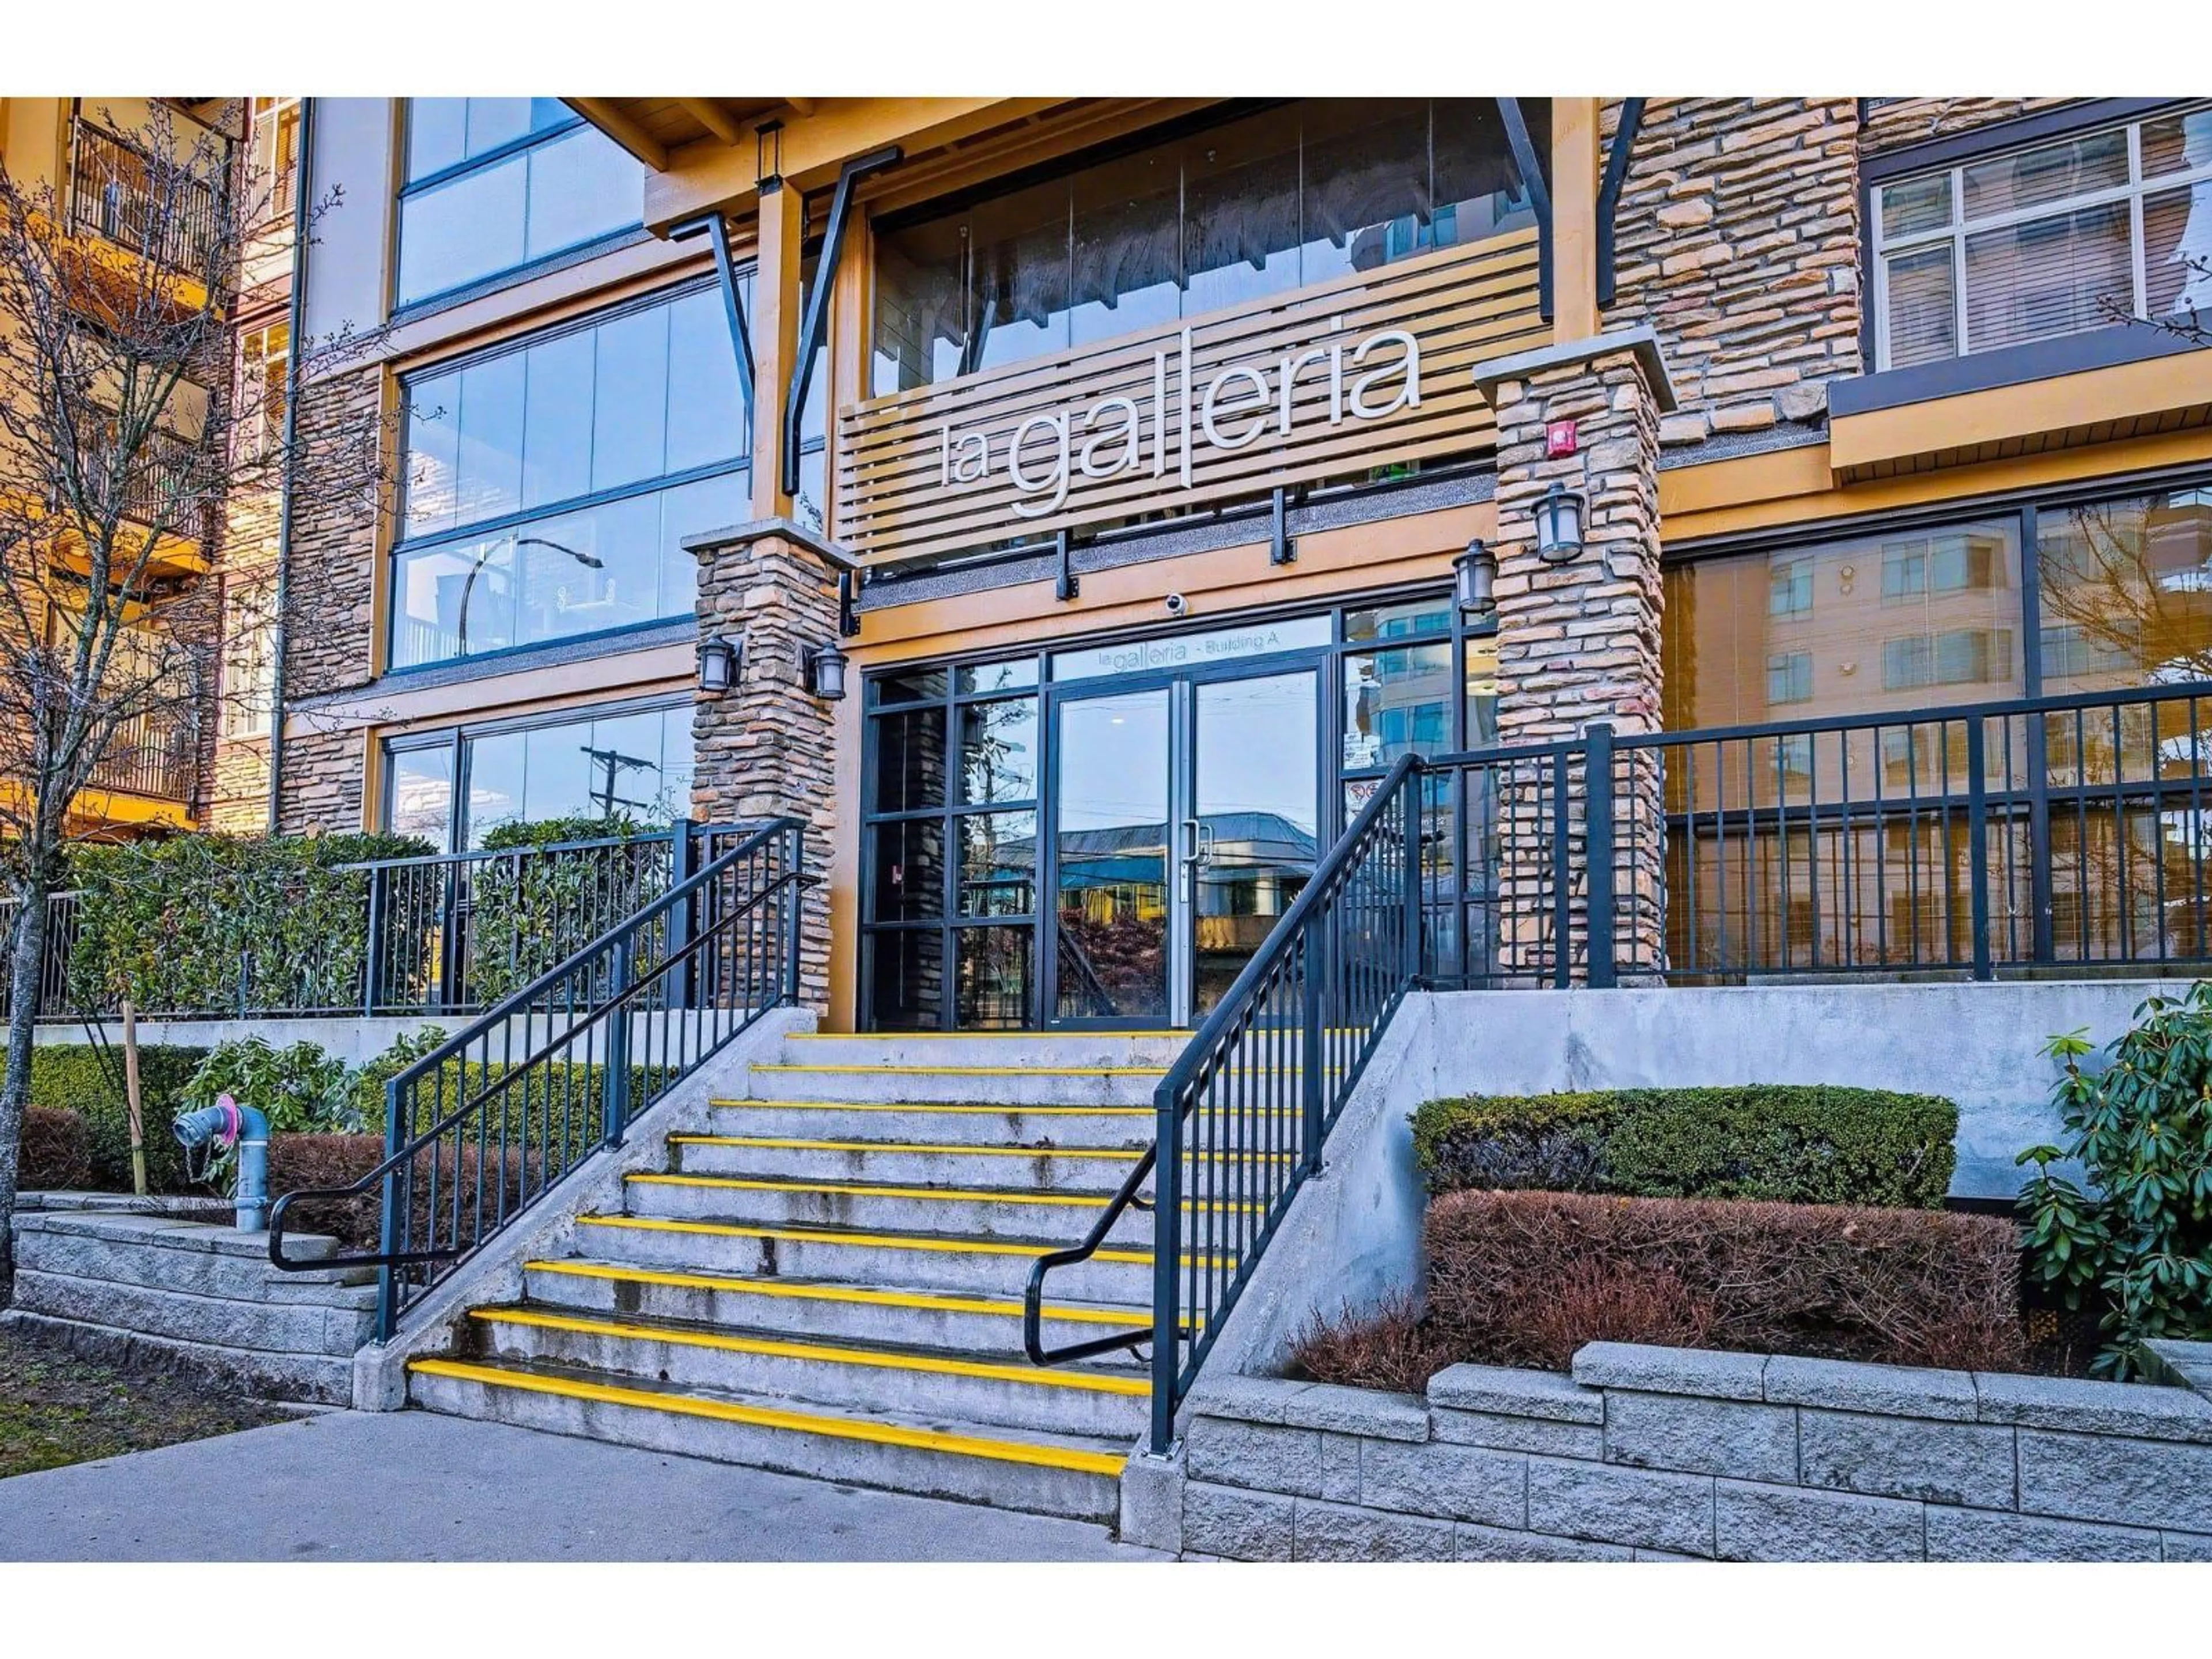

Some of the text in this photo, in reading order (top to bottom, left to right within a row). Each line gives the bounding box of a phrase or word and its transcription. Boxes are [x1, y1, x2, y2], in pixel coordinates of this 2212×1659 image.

[941, 315, 1422, 518] la galleria
[1113, 642, 1186, 673] galleria
[1205, 635, 1264, 654] Building
[1267, 631, 1278, 645] A
